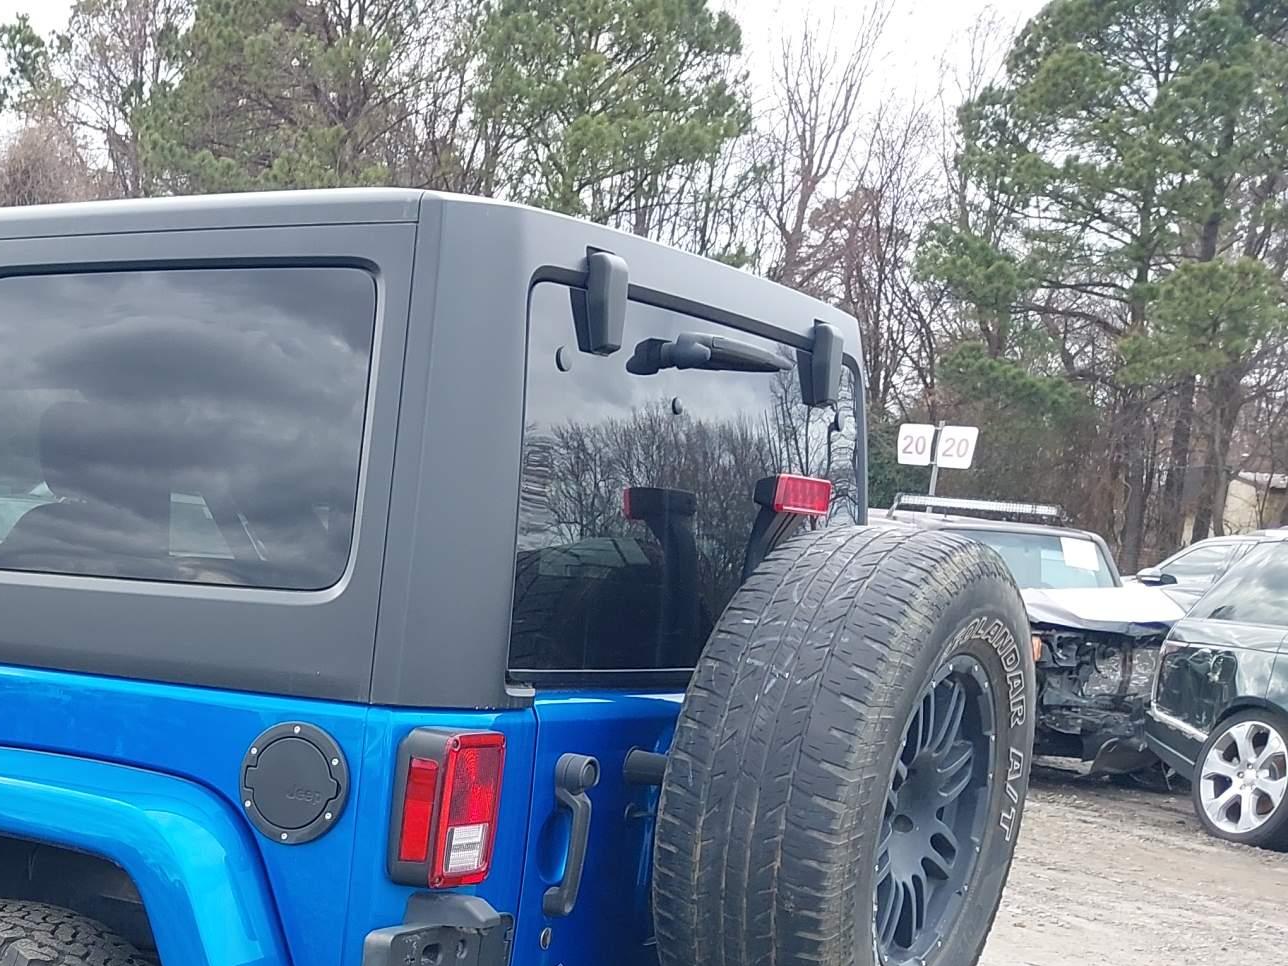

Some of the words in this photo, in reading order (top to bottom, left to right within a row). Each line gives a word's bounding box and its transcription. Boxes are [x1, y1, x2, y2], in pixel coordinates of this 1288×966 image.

[902, 435, 927, 456] 20
[942, 438, 970, 458] 20
[285, 785, 322, 806] Jeep
[998, 746, 1024, 842] A/T
